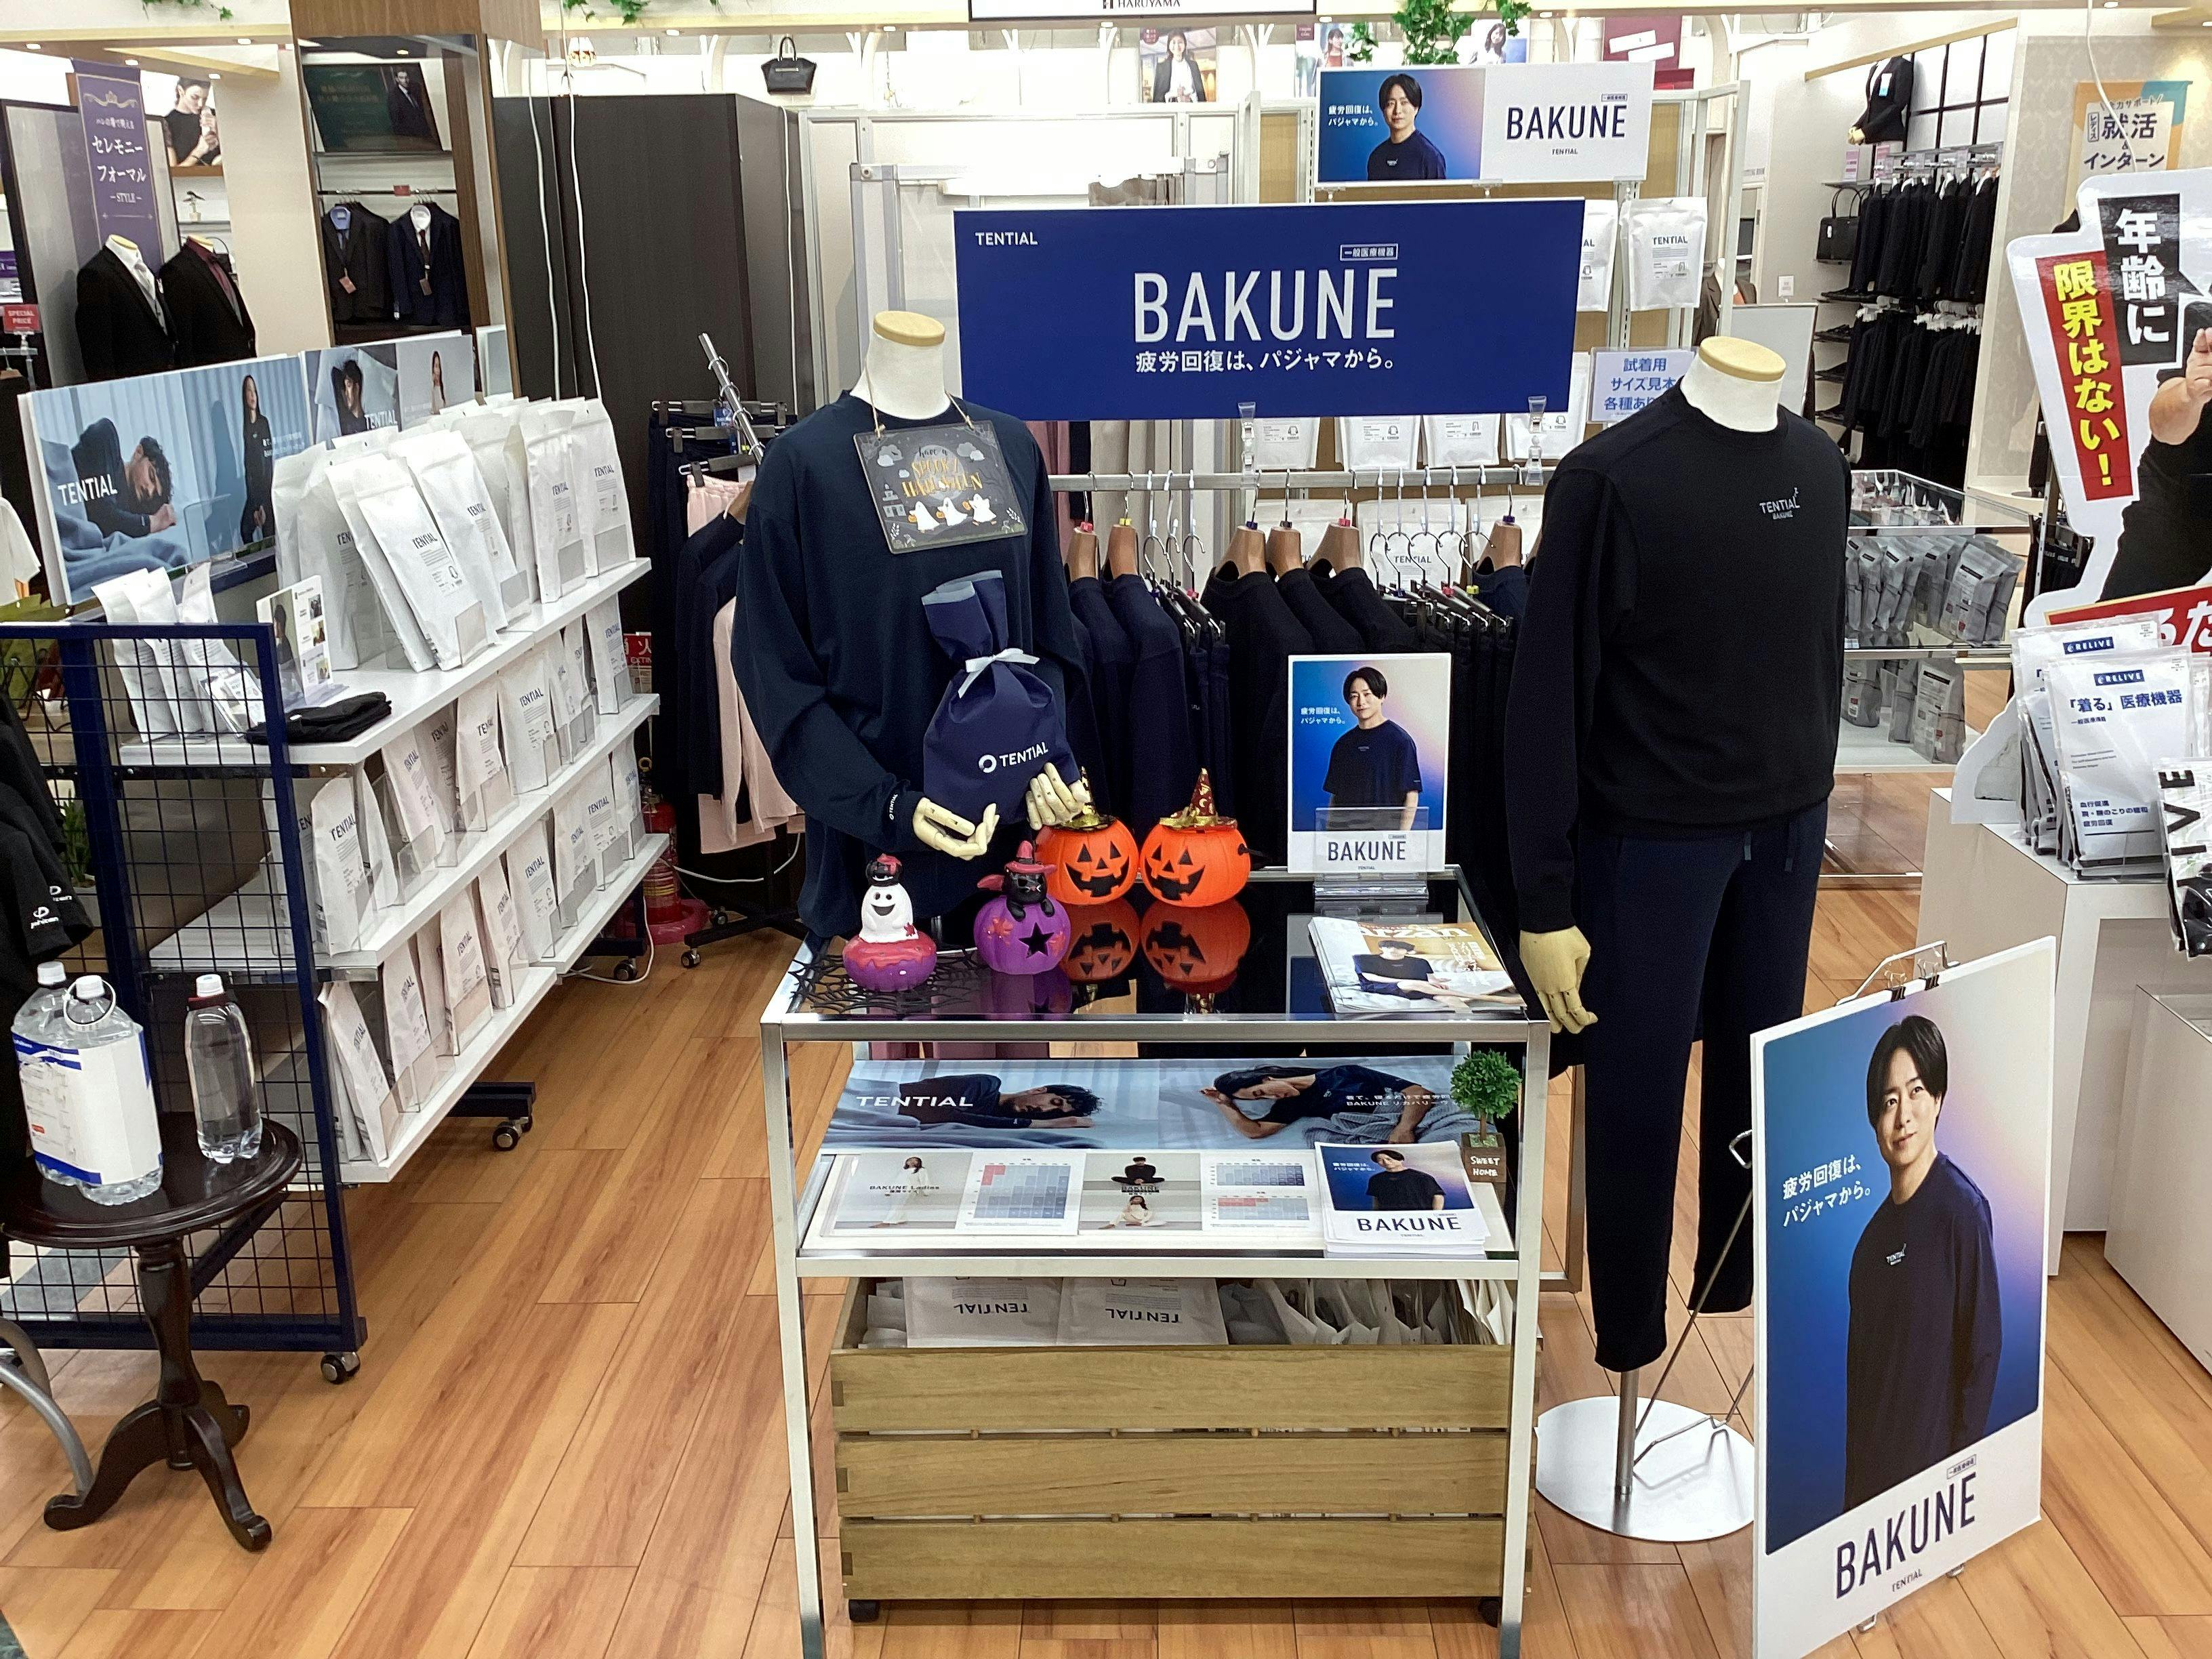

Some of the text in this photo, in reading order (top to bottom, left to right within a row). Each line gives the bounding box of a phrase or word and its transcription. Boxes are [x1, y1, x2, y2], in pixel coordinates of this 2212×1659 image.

[1507, 105, 1627, 140] BAKUNE
[91, 135, 143, 155] セレモニー
[2084, 152, 2165, 170] インターン
[97, 165, 146, 182] フォーマル
[975, 232, 1038, 246] TENTIAL
[1652, 235, 1688, 245] TENTIAL
[2115, 207, 2169, 346] 年齢に
[1134, 268, 1397, 343] BAKUNE
[1136, 346, 1394, 373] 疲労回復は、パジャマから。
[1623, 358, 1666, 372] 試着用
[2053, 260, 2121, 487] 限界はない！
[1611, 377, 1676, 391] サイズ見本
[57, 474, 118, 506] TENTIAL
[1759, 495, 1801, 514] TENTIAL
[412, 532, 438, 549] TENTIAL
[2075, 638, 2112, 651] RELIVE
[2106, 672, 2142, 683] RELIVE
[519, 687, 544, 708] TENTIAL
[2070, 689, 2183, 713] 「着る」 医療機器
[1000, 741, 1049, 767] TENTIAL
[588, 796, 609, 815] TENTIAL
[331, 813, 357, 841] TENTIAL
[1328, 841, 1406, 861] BAKUNE
[525, 855, 545, 879] TENTIAL
[856, 1096, 974, 1107] TENTIAL
[1470, 1155, 1500, 1166] SWEET
[1473, 1168, 1498, 1176] HOME
[1782, 1154, 1861, 1200] 疲労回復は、
[1782, 1181, 1871, 1227] パジャマから。
[1357, 1216, 1462, 1231] BAKUNE
[954, 1302, 1029, 1315] TENTIAL
[1105, 1308, 1180, 1324] TENTIAL
[1836, 1472, 1977, 1599] BAKUNE
[1892, 1568, 1923, 1592] TENTIAL
